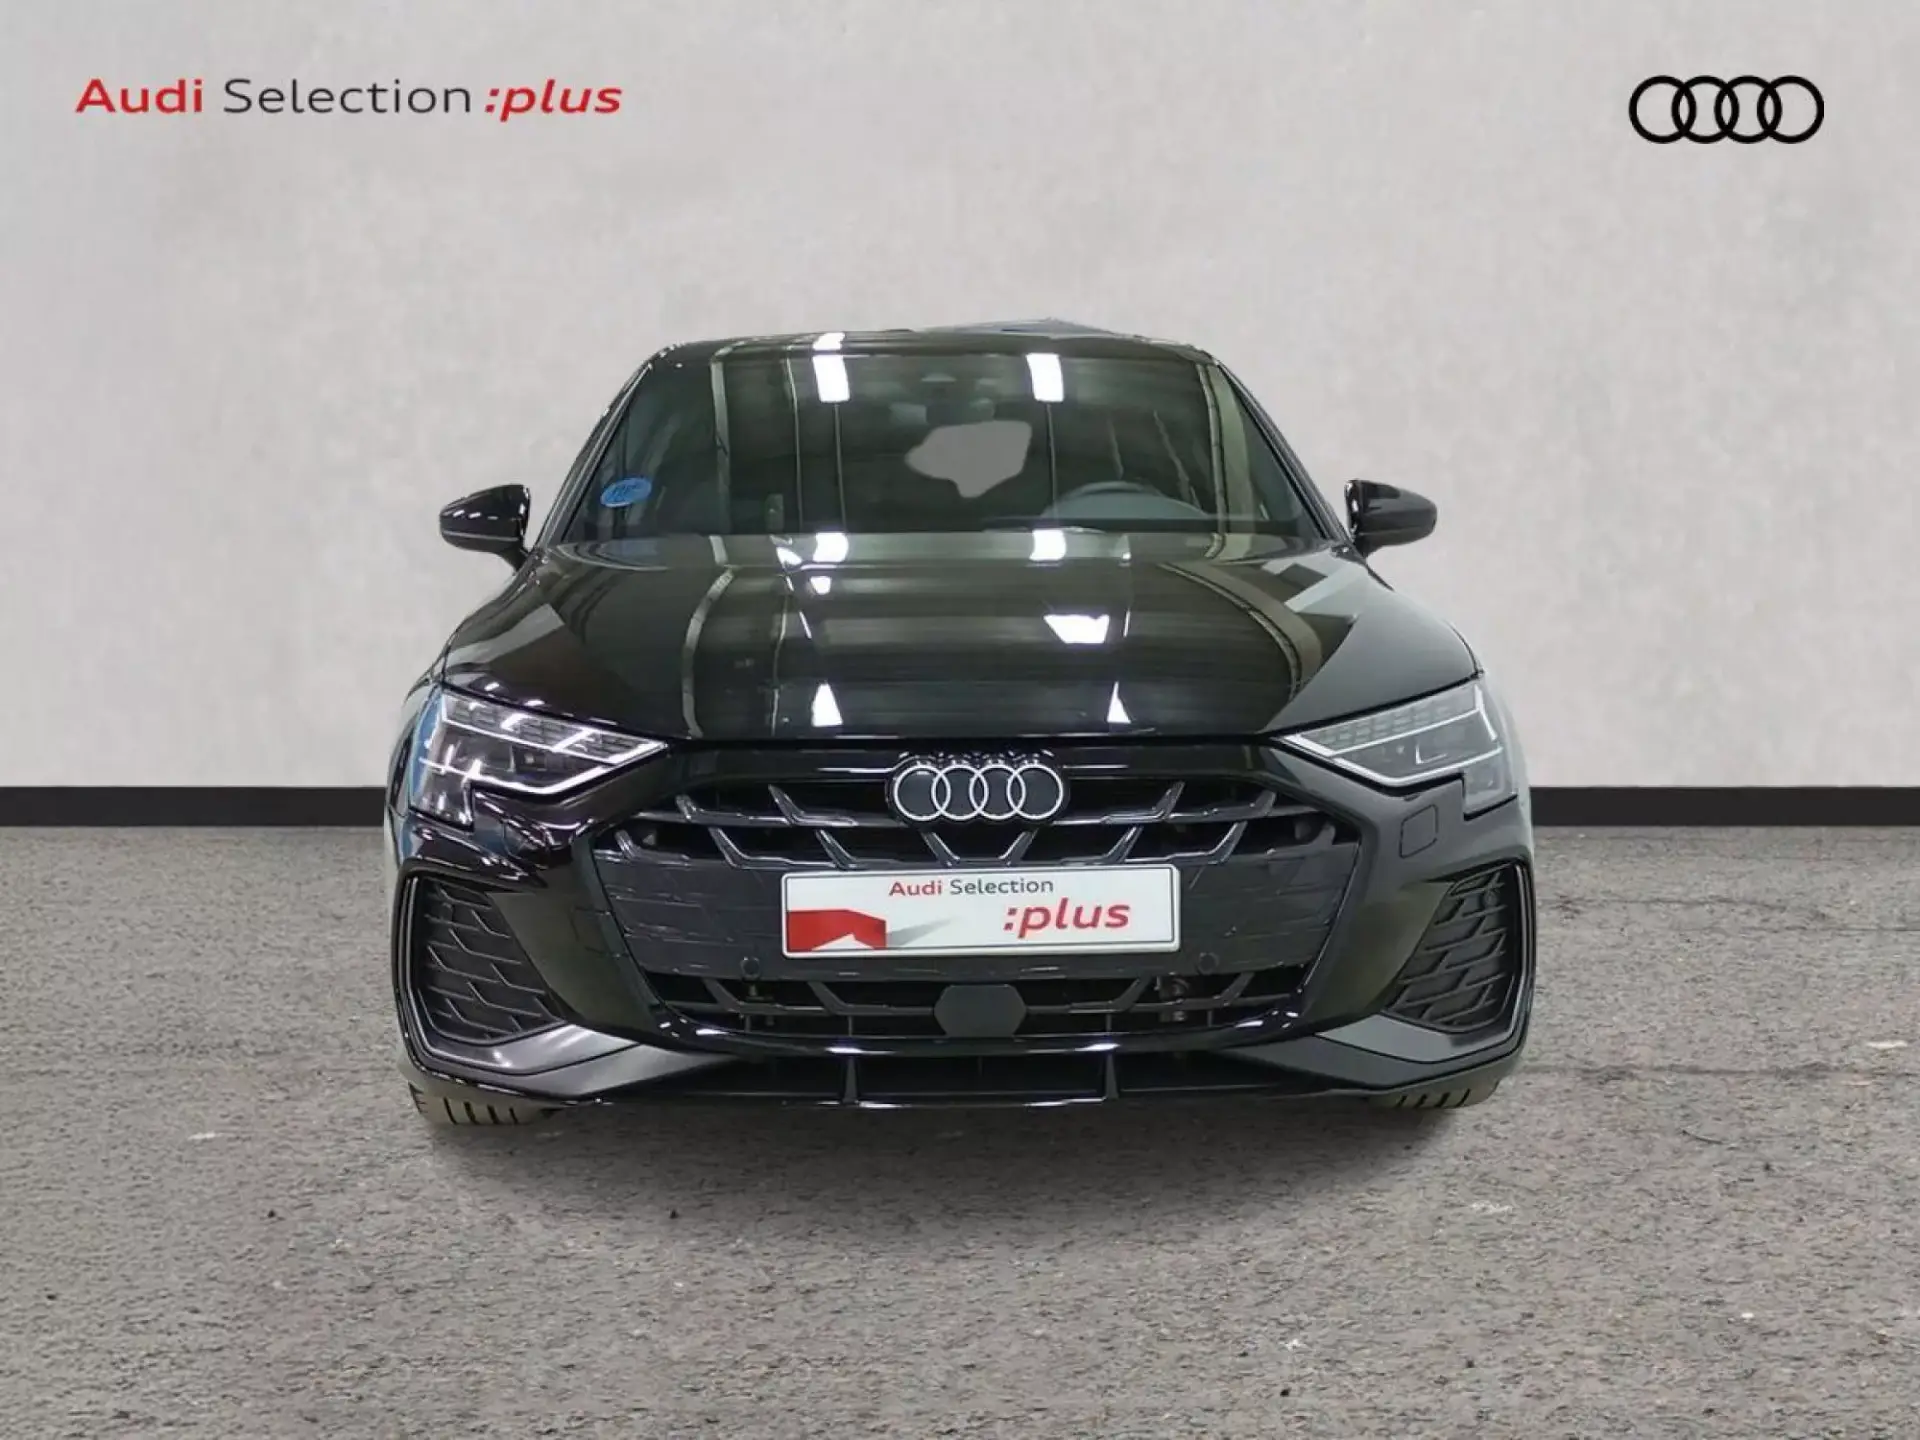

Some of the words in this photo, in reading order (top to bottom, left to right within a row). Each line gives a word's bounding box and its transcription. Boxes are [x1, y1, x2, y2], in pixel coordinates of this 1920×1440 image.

[888, 880, 943, 897] Audi
[949, 877, 1054, 896] Selection
[1003, 897, 1131, 939] :plus
